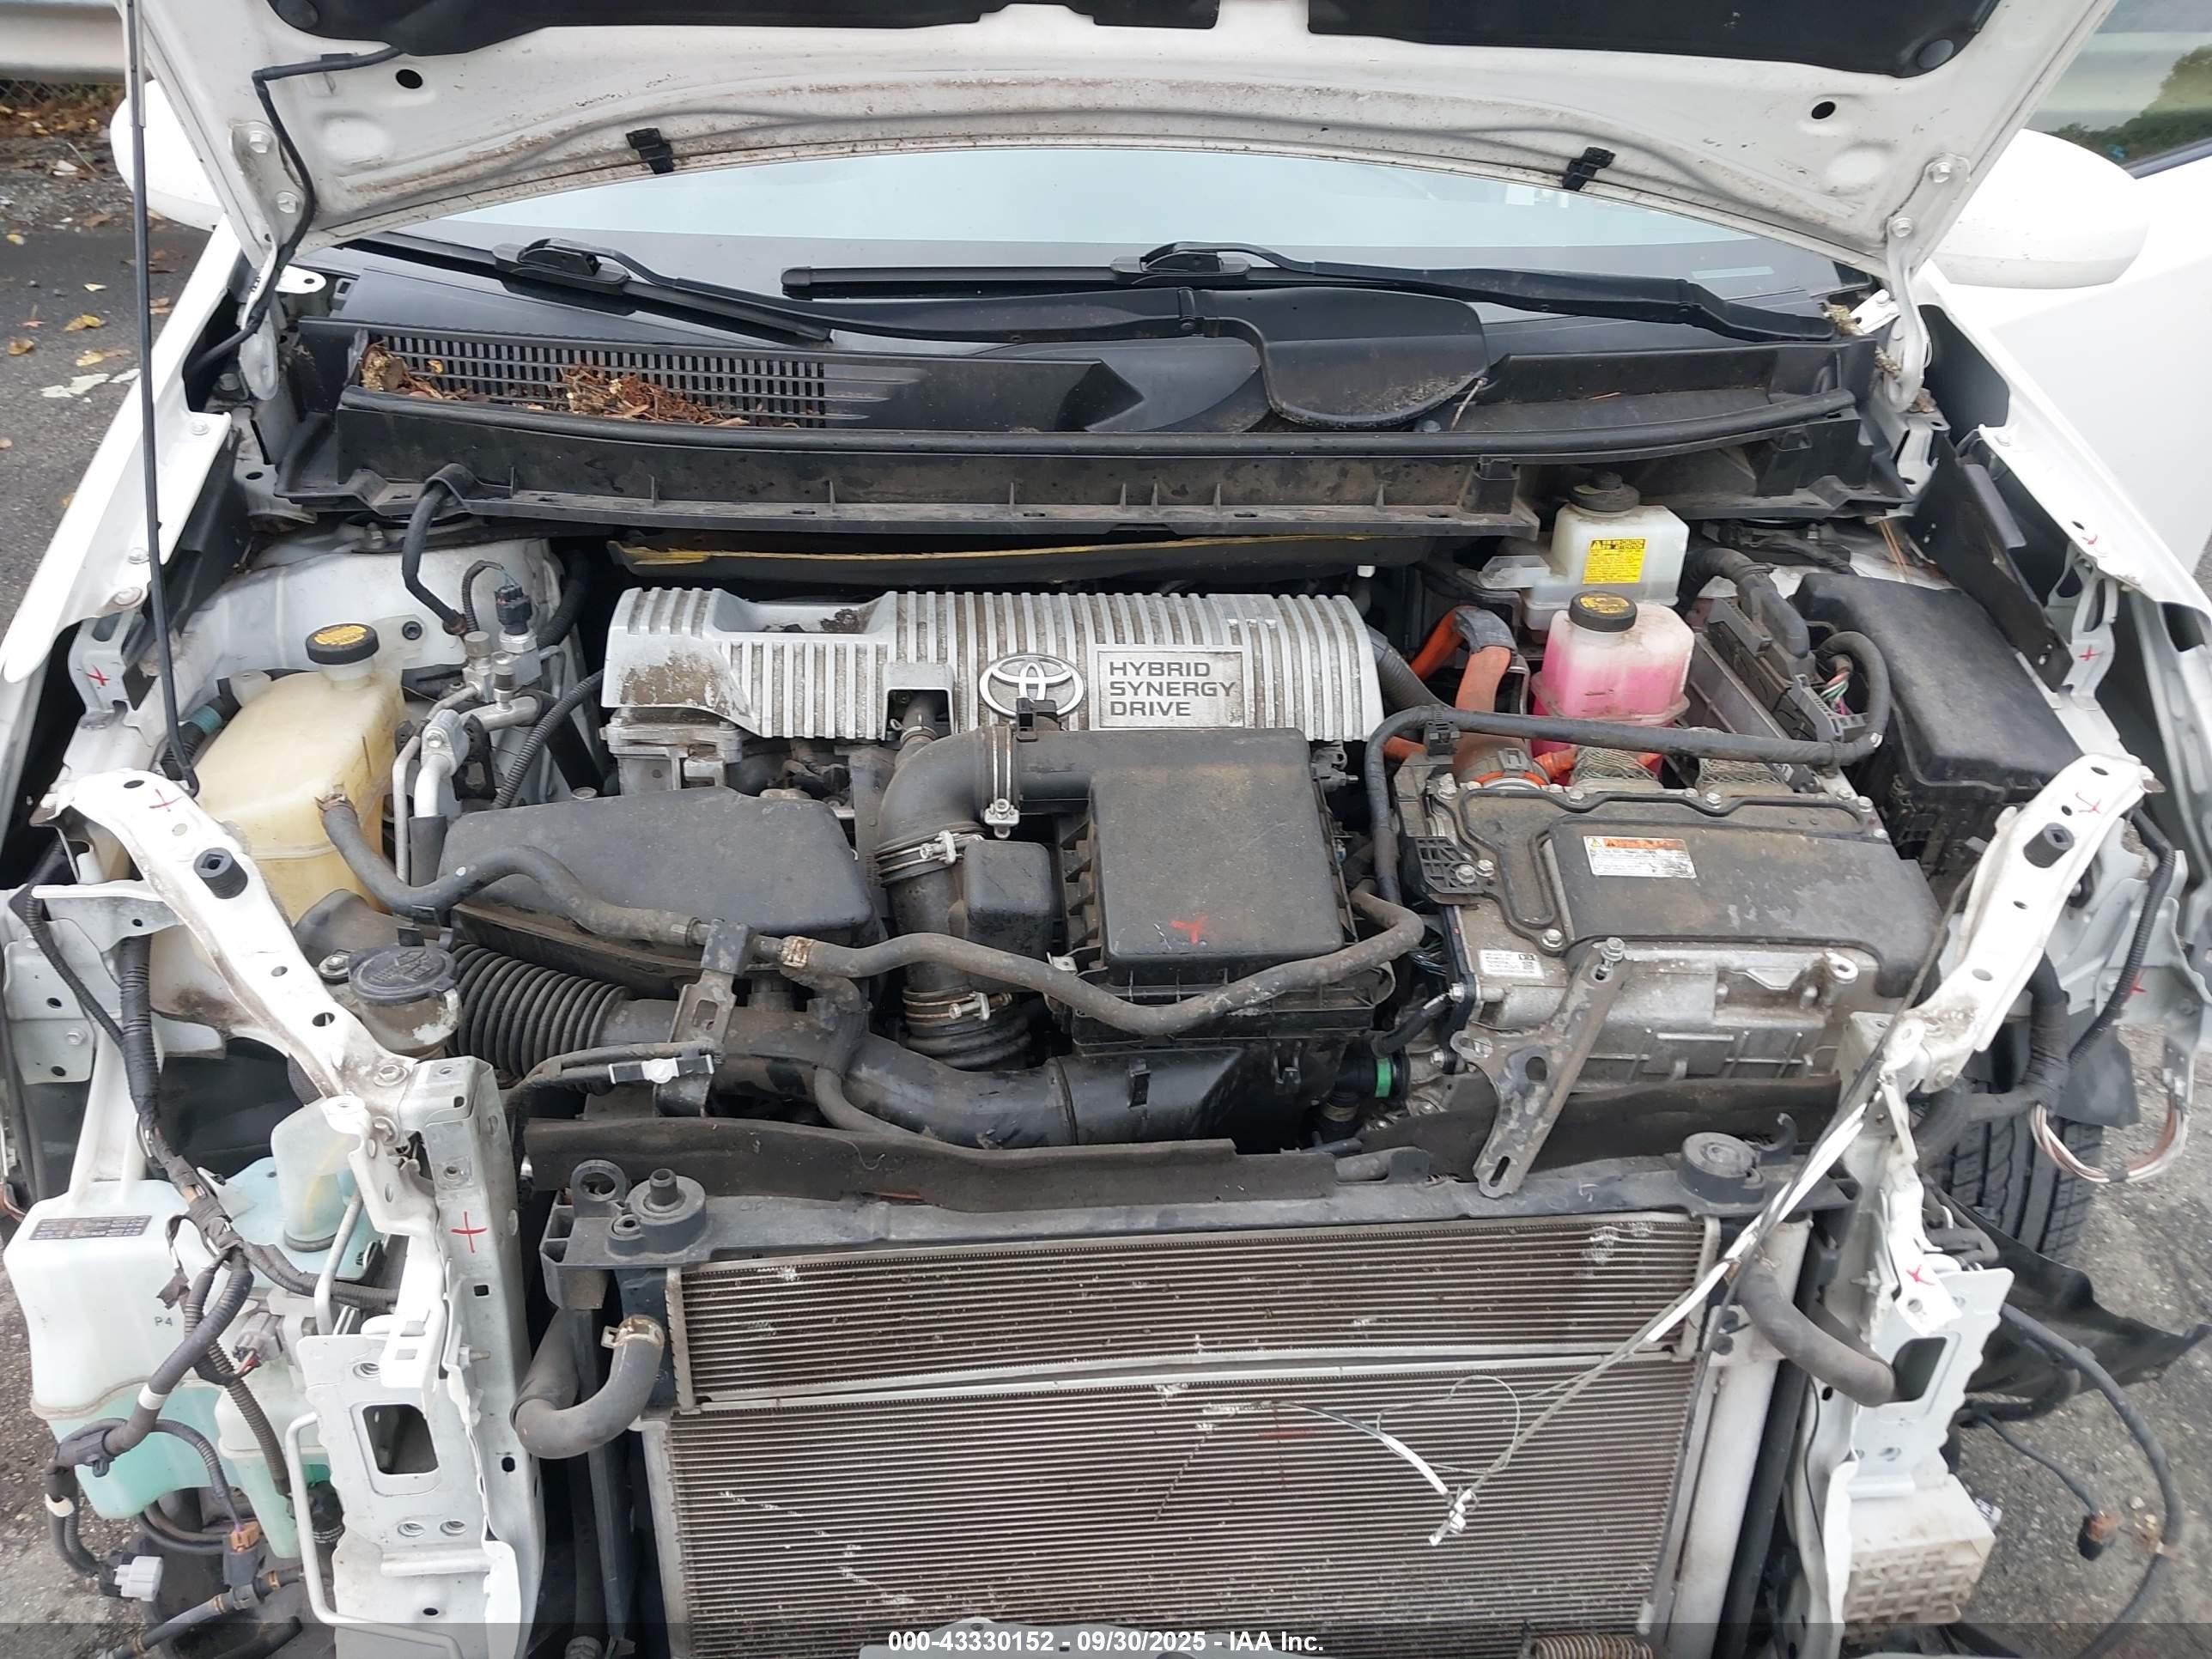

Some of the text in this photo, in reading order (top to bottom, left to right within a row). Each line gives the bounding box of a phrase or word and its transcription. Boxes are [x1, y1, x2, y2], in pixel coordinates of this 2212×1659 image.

[1109, 662, 1211, 677] HYBRID
[1109, 681, 1236, 697] SYNERGY
[1109, 701, 1191, 716] DRIVE
